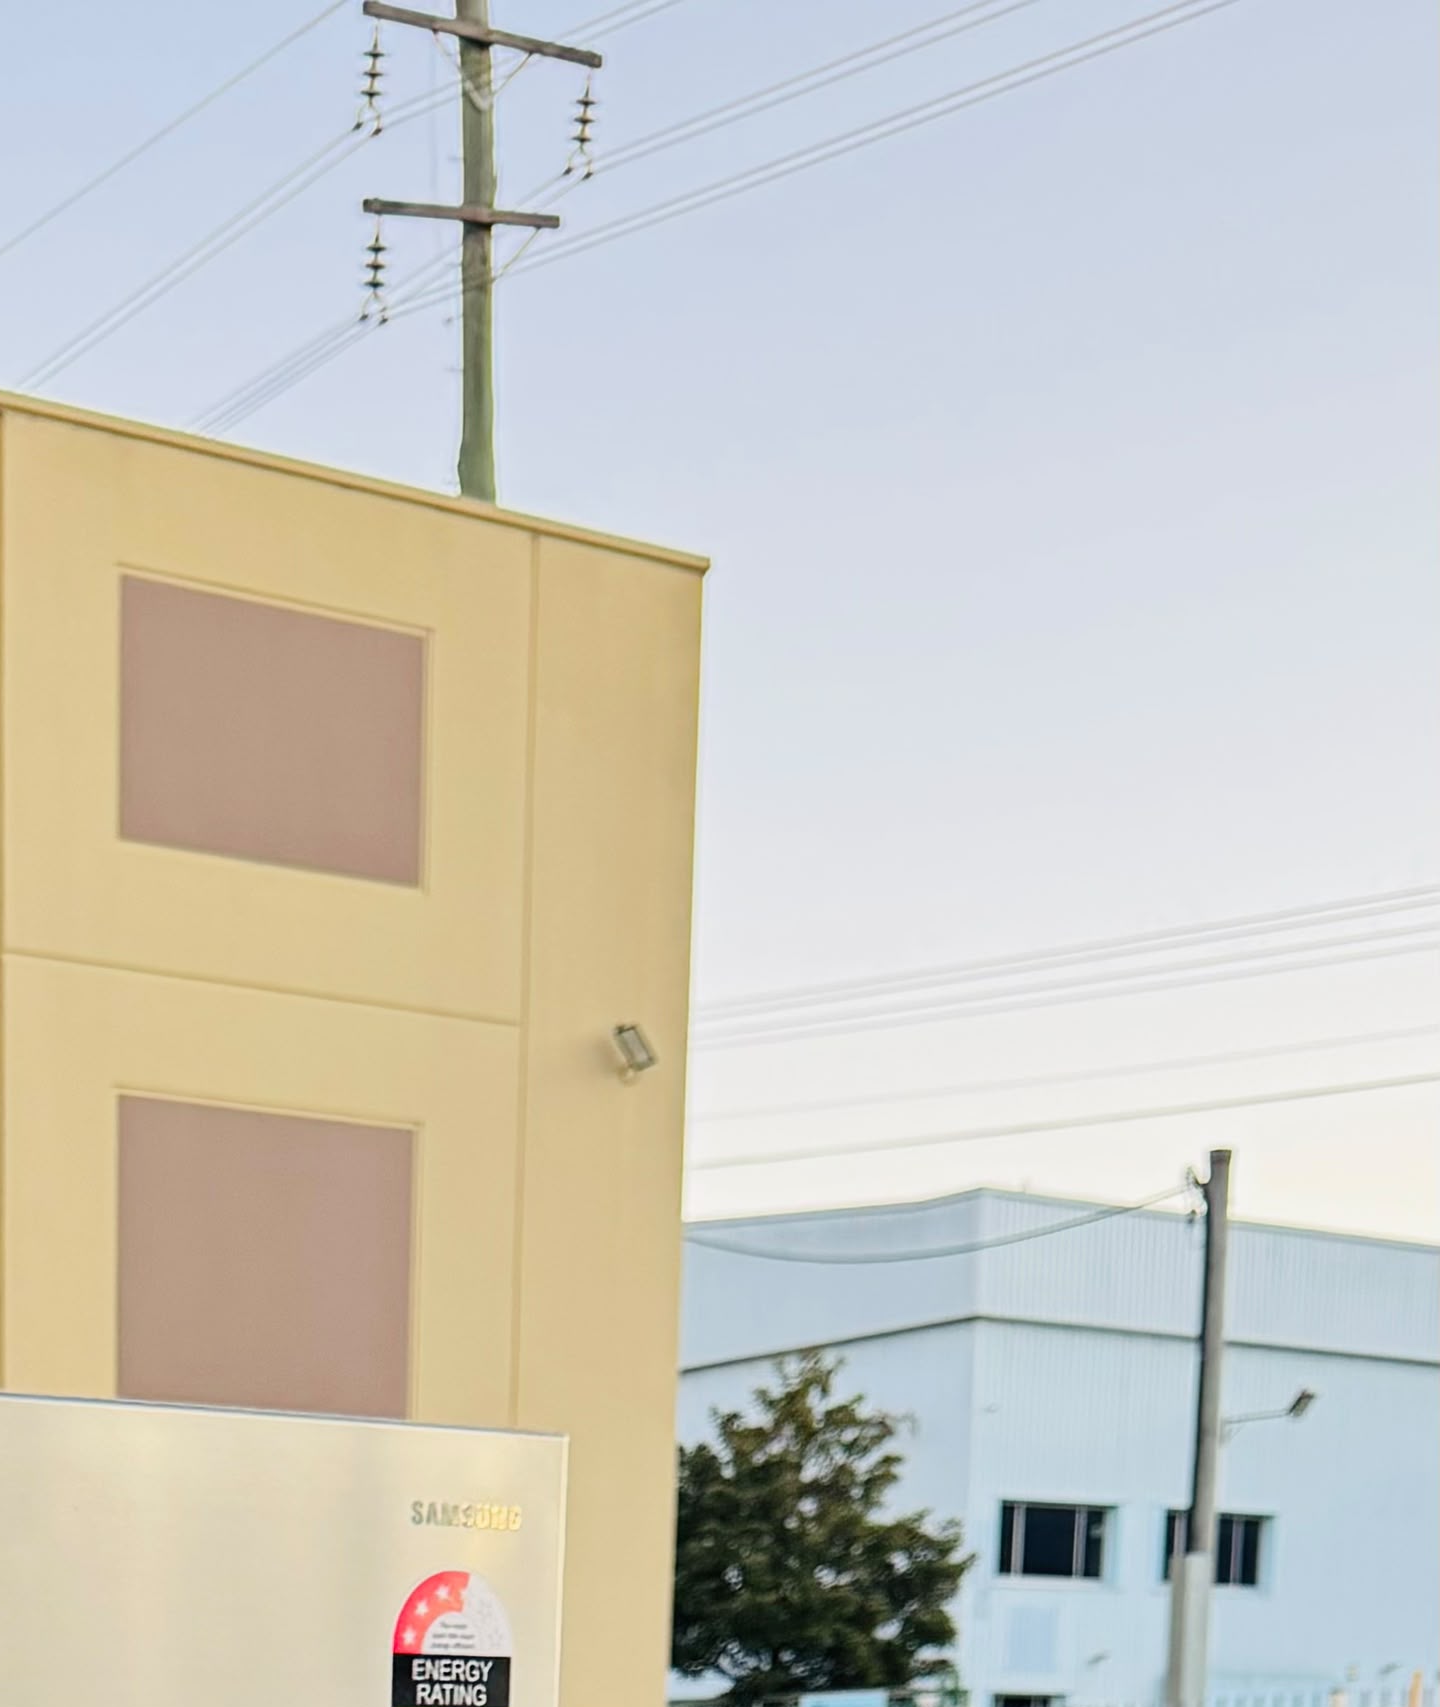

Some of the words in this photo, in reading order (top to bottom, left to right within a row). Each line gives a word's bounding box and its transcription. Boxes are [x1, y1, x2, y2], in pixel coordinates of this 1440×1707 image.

[411, 1500, 521, 1530] SAMSUNG
[411, 1658, 493, 1682] ENERGY
[415, 1683, 488, 1706] RATING
